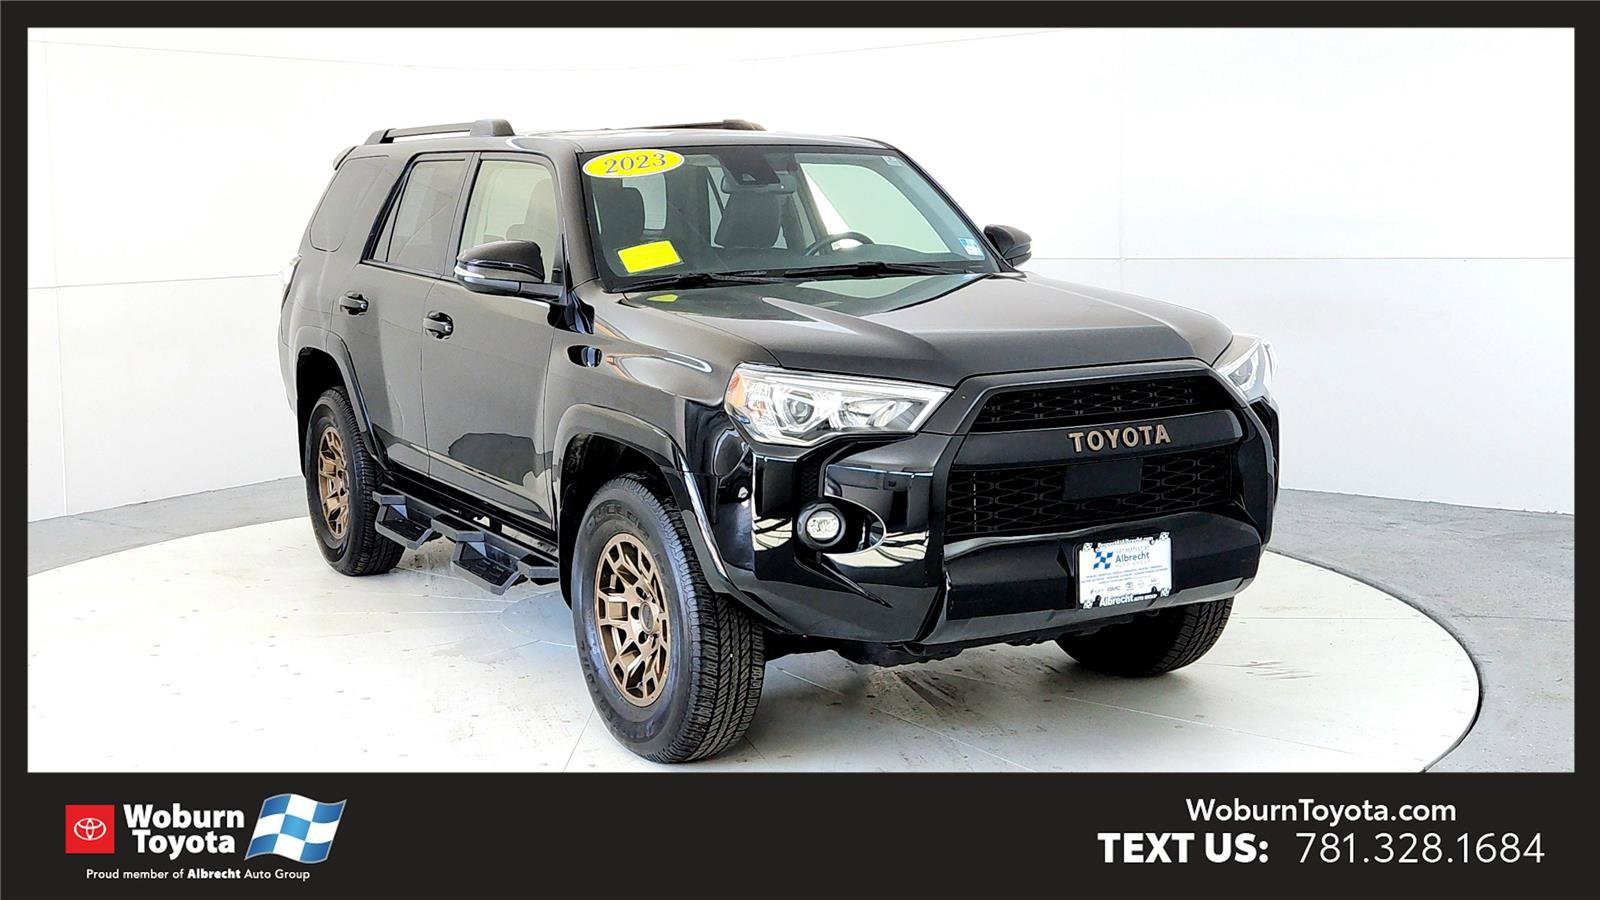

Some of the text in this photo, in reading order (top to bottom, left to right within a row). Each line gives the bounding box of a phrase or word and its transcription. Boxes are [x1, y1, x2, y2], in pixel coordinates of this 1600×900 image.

[604, 153, 668, 174] 2023
[1068, 424, 1171, 453] TOYOTA
[1115, 550, 1150, 563] Albrecht
[1099, 594, 1134, 608] Albrecht
